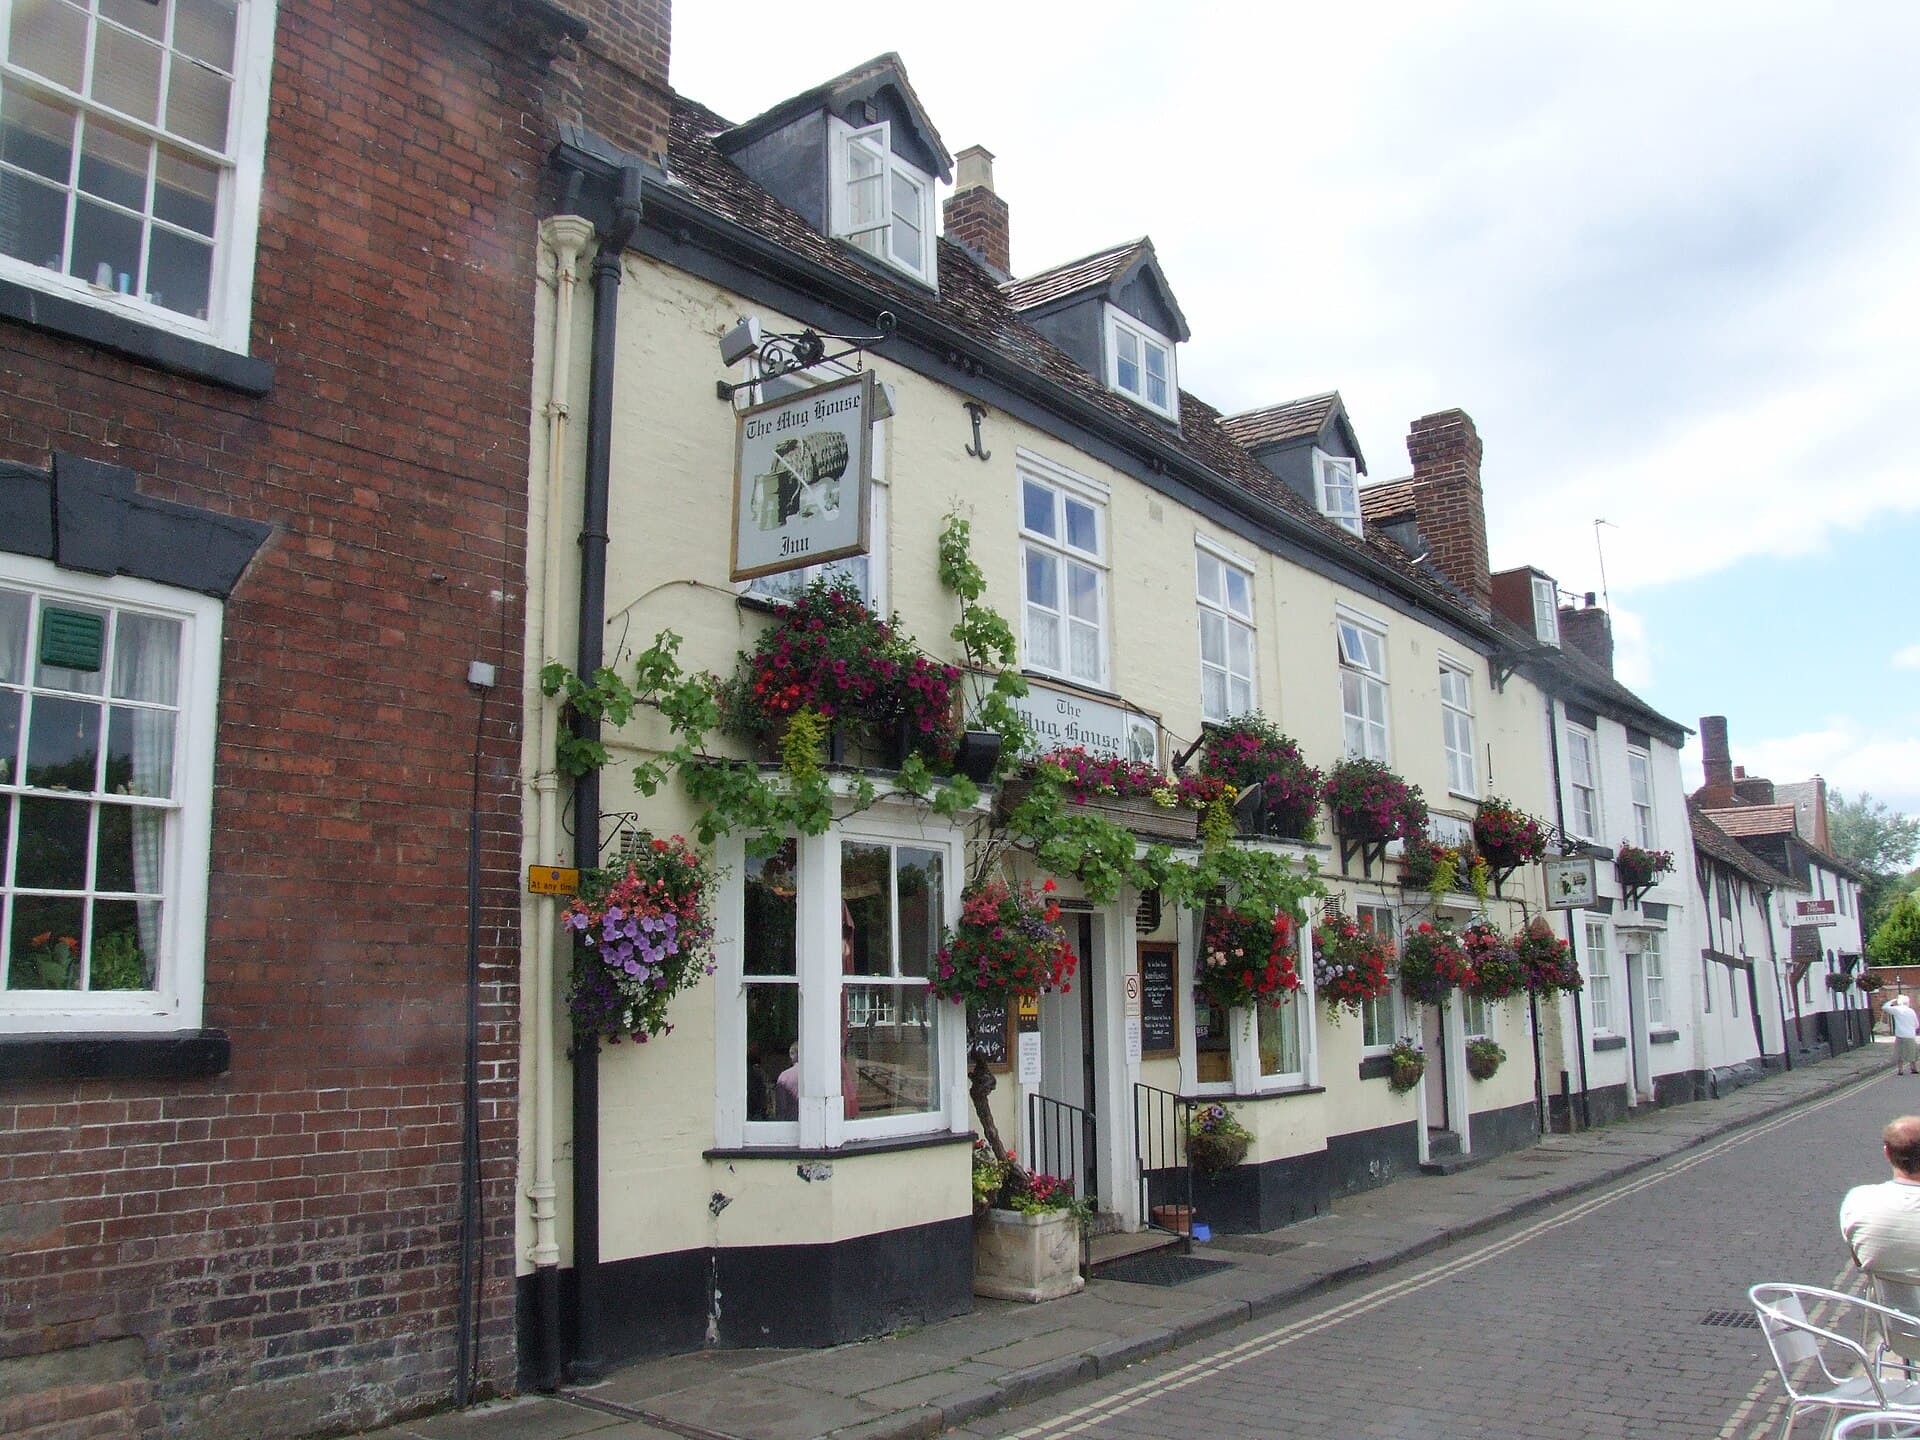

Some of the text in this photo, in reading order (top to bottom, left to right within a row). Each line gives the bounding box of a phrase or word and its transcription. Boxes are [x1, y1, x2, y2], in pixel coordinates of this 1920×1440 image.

[746, 394, 861, 439] The Mug House
[779, 535, 809, 557] Inn
[1056, 698, 1081, 719] The
[1064, 721, 1120, 750] House
[531, 881, 540, 889] At
[544, 883, 557, 891] any
